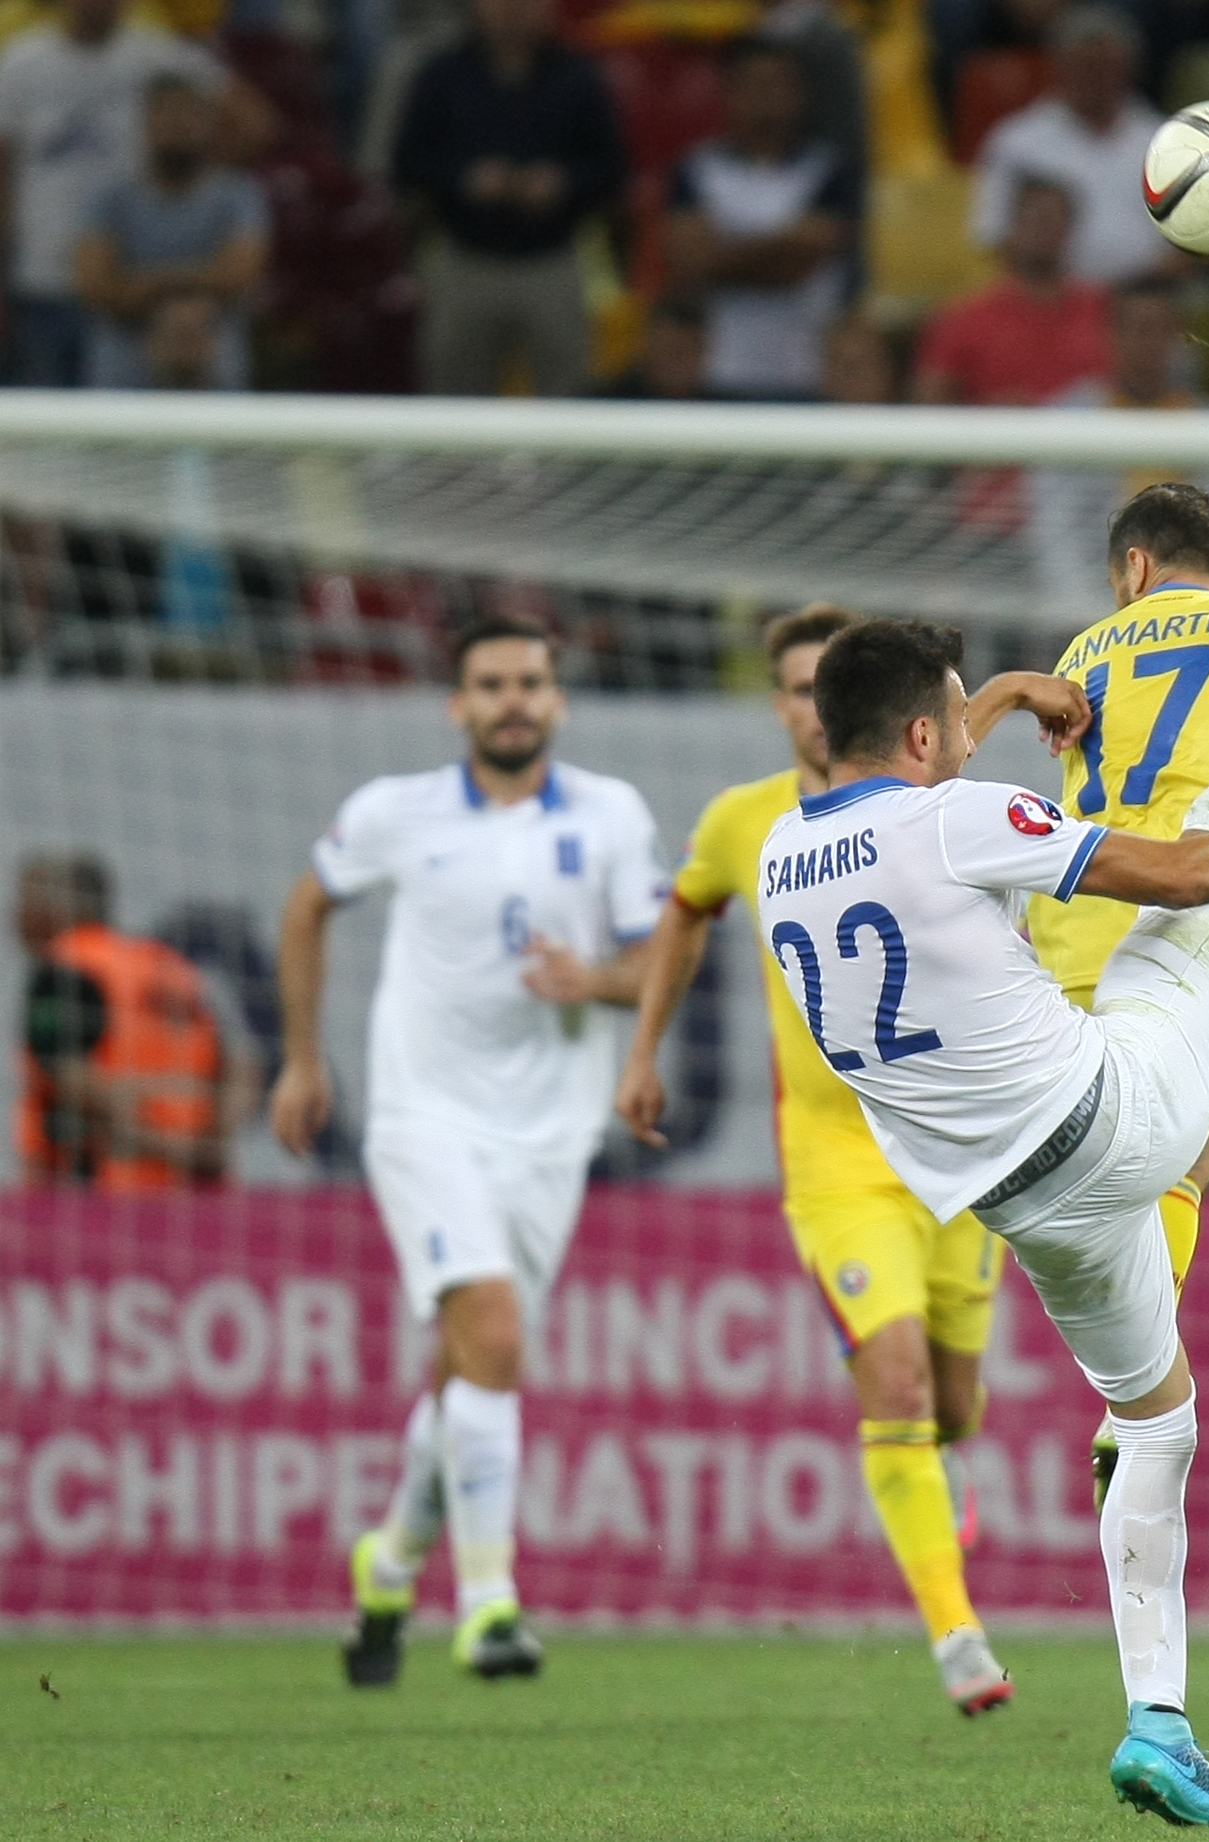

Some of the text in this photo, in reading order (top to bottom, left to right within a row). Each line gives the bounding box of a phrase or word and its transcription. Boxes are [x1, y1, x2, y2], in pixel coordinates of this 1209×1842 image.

[765, 828, 879, 898] SAMARIS
[501, 894, 530, 956] 6
[771, 900, 944, 1072] 22
[0, 1278, 361, 1397] NSOR
